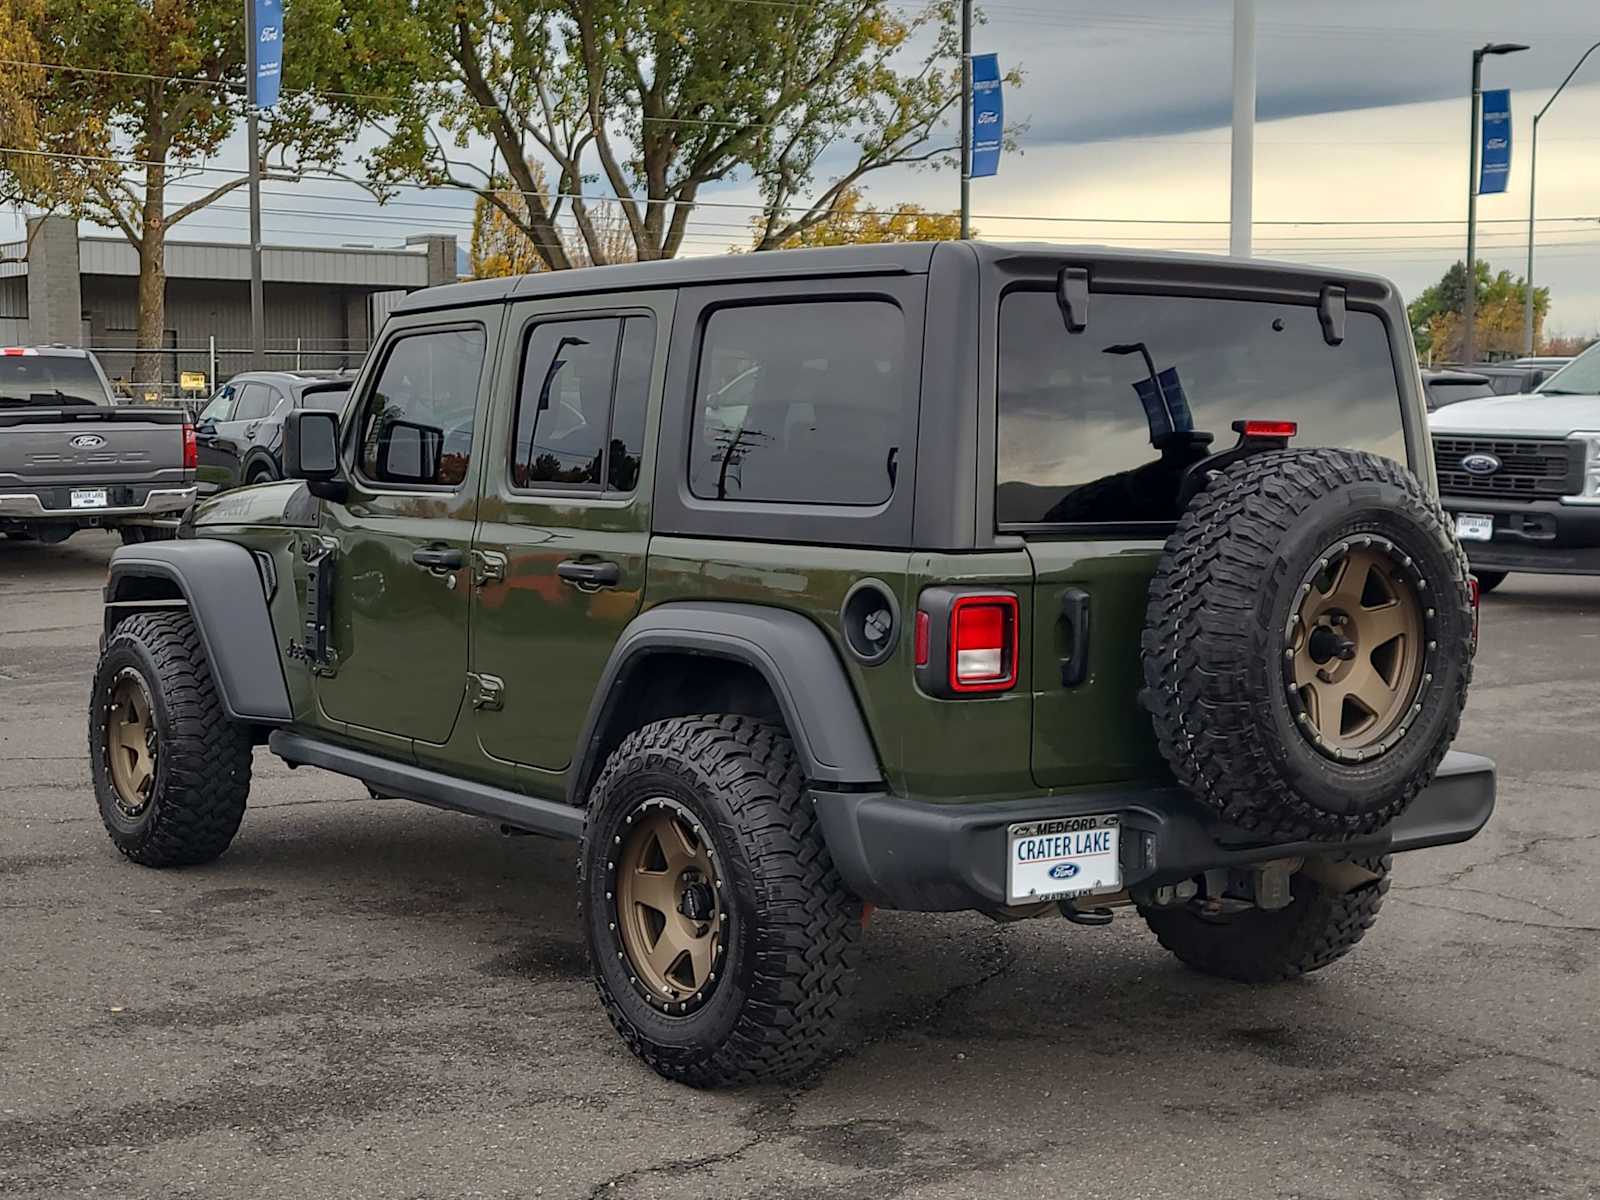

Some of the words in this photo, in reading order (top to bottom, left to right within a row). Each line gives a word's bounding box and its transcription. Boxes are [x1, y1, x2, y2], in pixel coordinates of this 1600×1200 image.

[1037, 818, 1097, 835] MEDFORD
[1018, 836, 1071, 861] CRATER
[1076, 831, 1110, 854] LAKE
[1053, 864, 1076, 878] Ford
